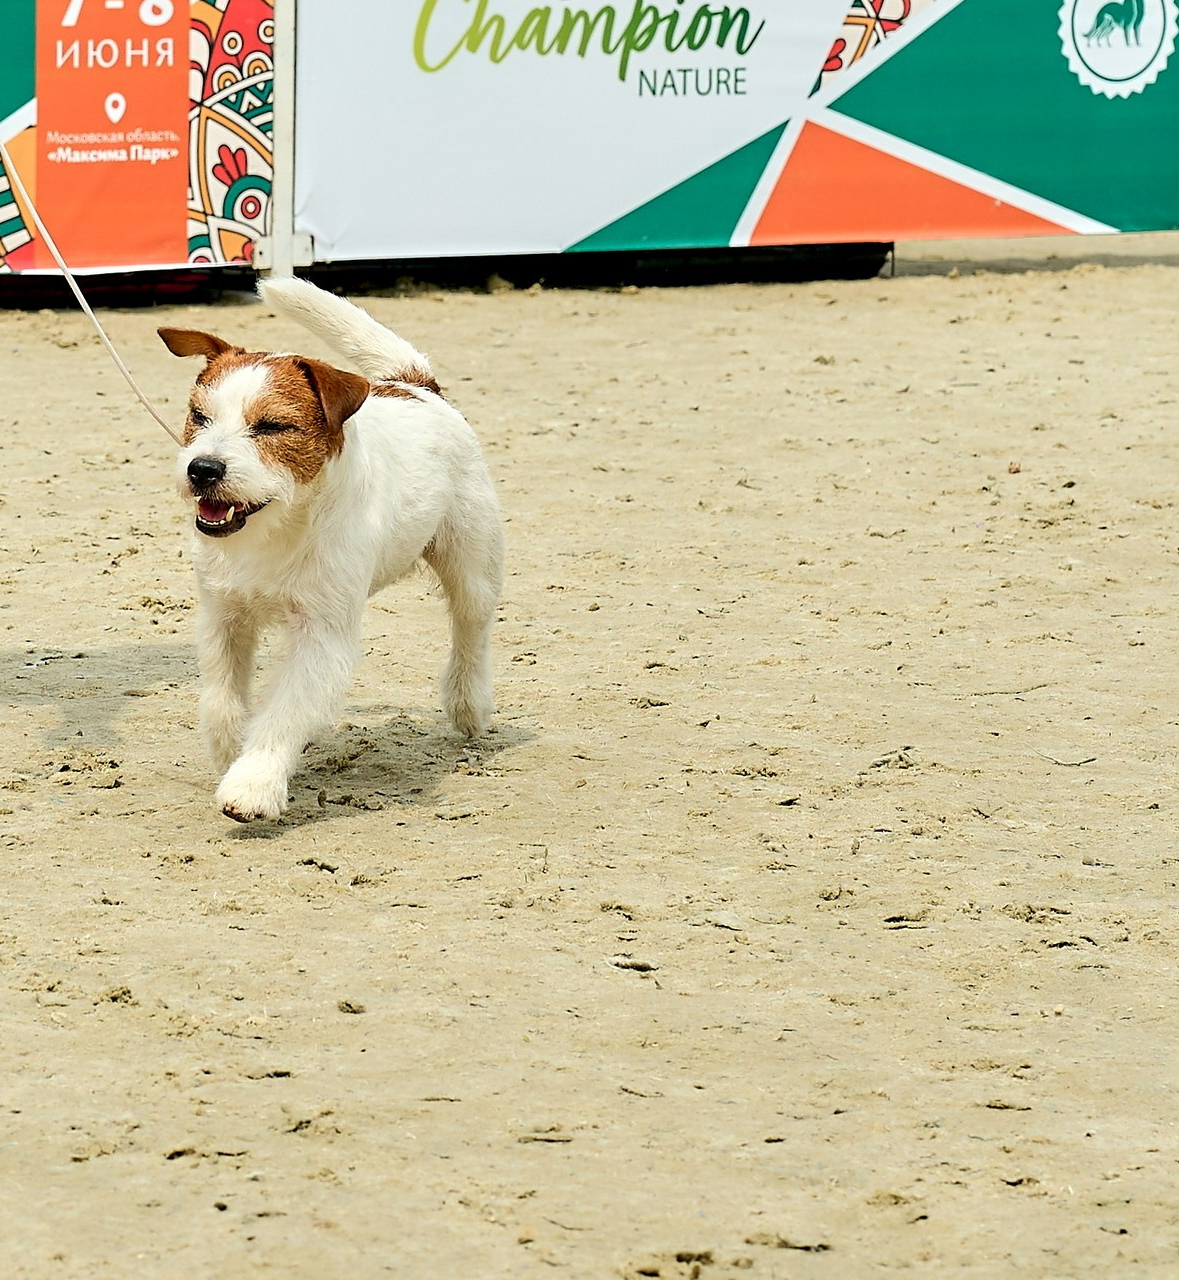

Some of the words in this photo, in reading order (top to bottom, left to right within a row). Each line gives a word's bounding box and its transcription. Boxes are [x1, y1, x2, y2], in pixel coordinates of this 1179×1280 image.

[56, 37, 174, 69] ИЮНЯ
[638, 67, 748, 97] NATURE
[46, 130, 125, 145] Московская
[47, 147, 128, 163] «Максима
[129, 144, 179, 165] Парк»
